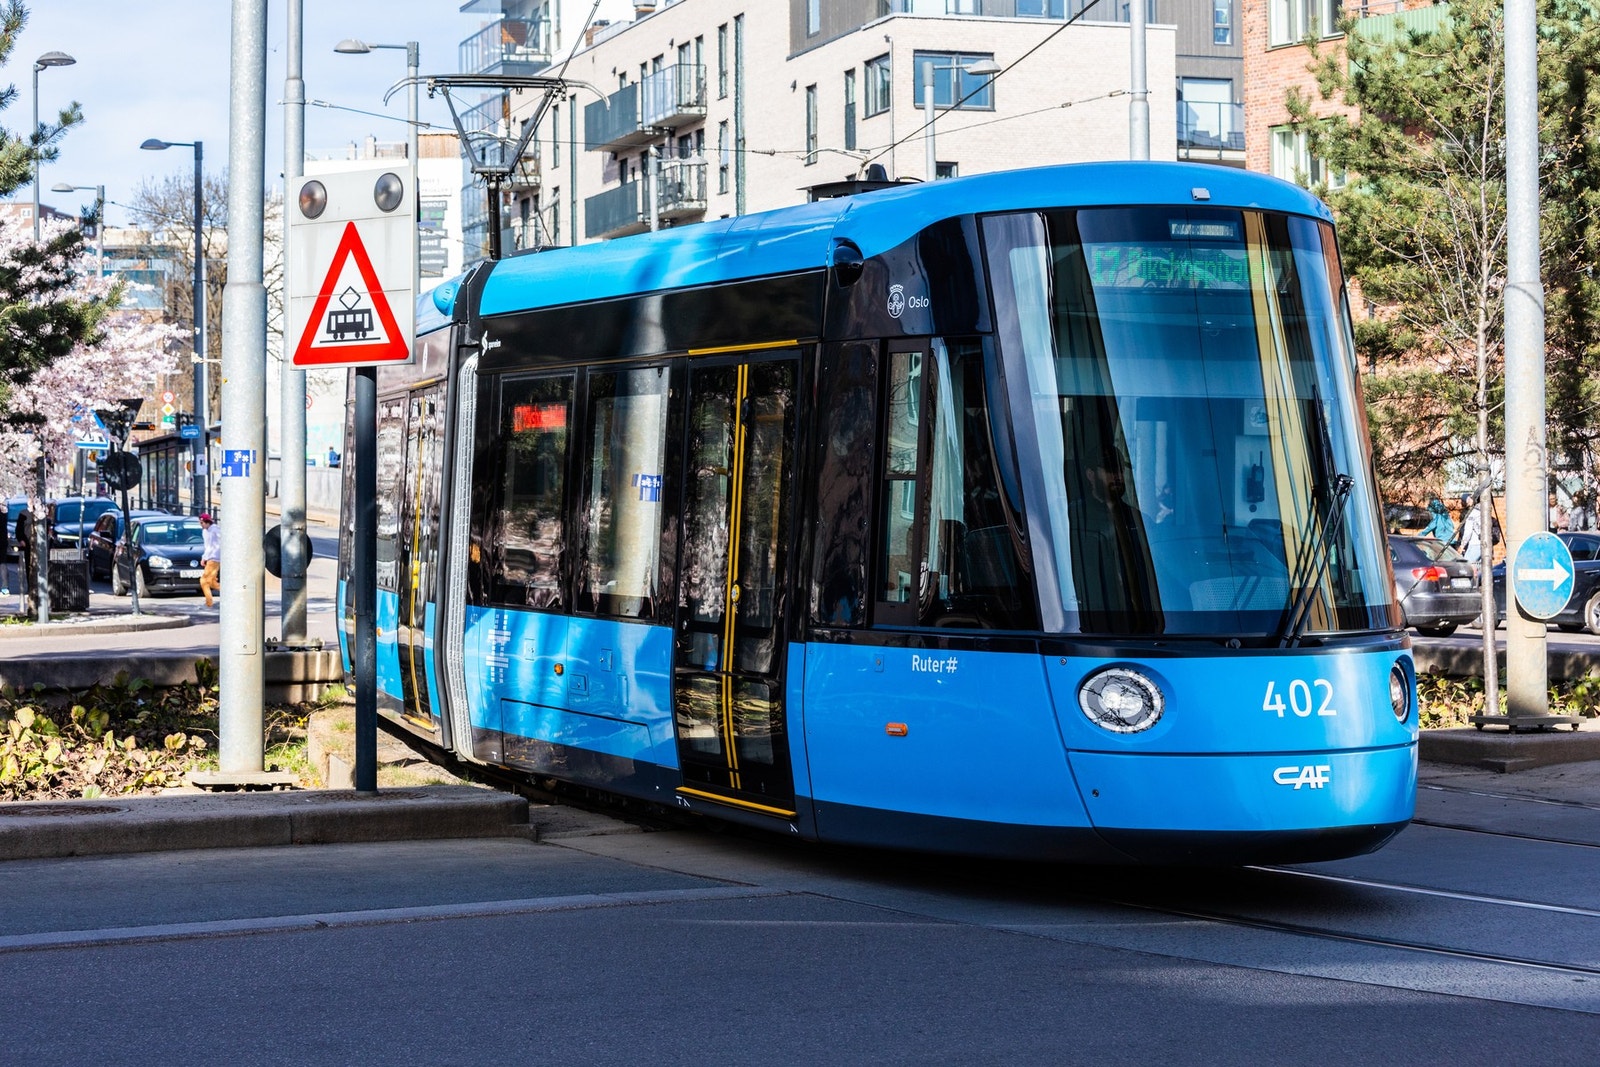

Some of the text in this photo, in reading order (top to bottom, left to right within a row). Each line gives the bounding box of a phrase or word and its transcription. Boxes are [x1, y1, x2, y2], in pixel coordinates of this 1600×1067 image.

[1093, 250, 1120, 283] 17
[908, 295, 930, 309] Oslo
[912, 654, 958, 674] Ruter#
[1262, 678, 1338, 718] 402
[1273, 764, 1331, 790] CAF
